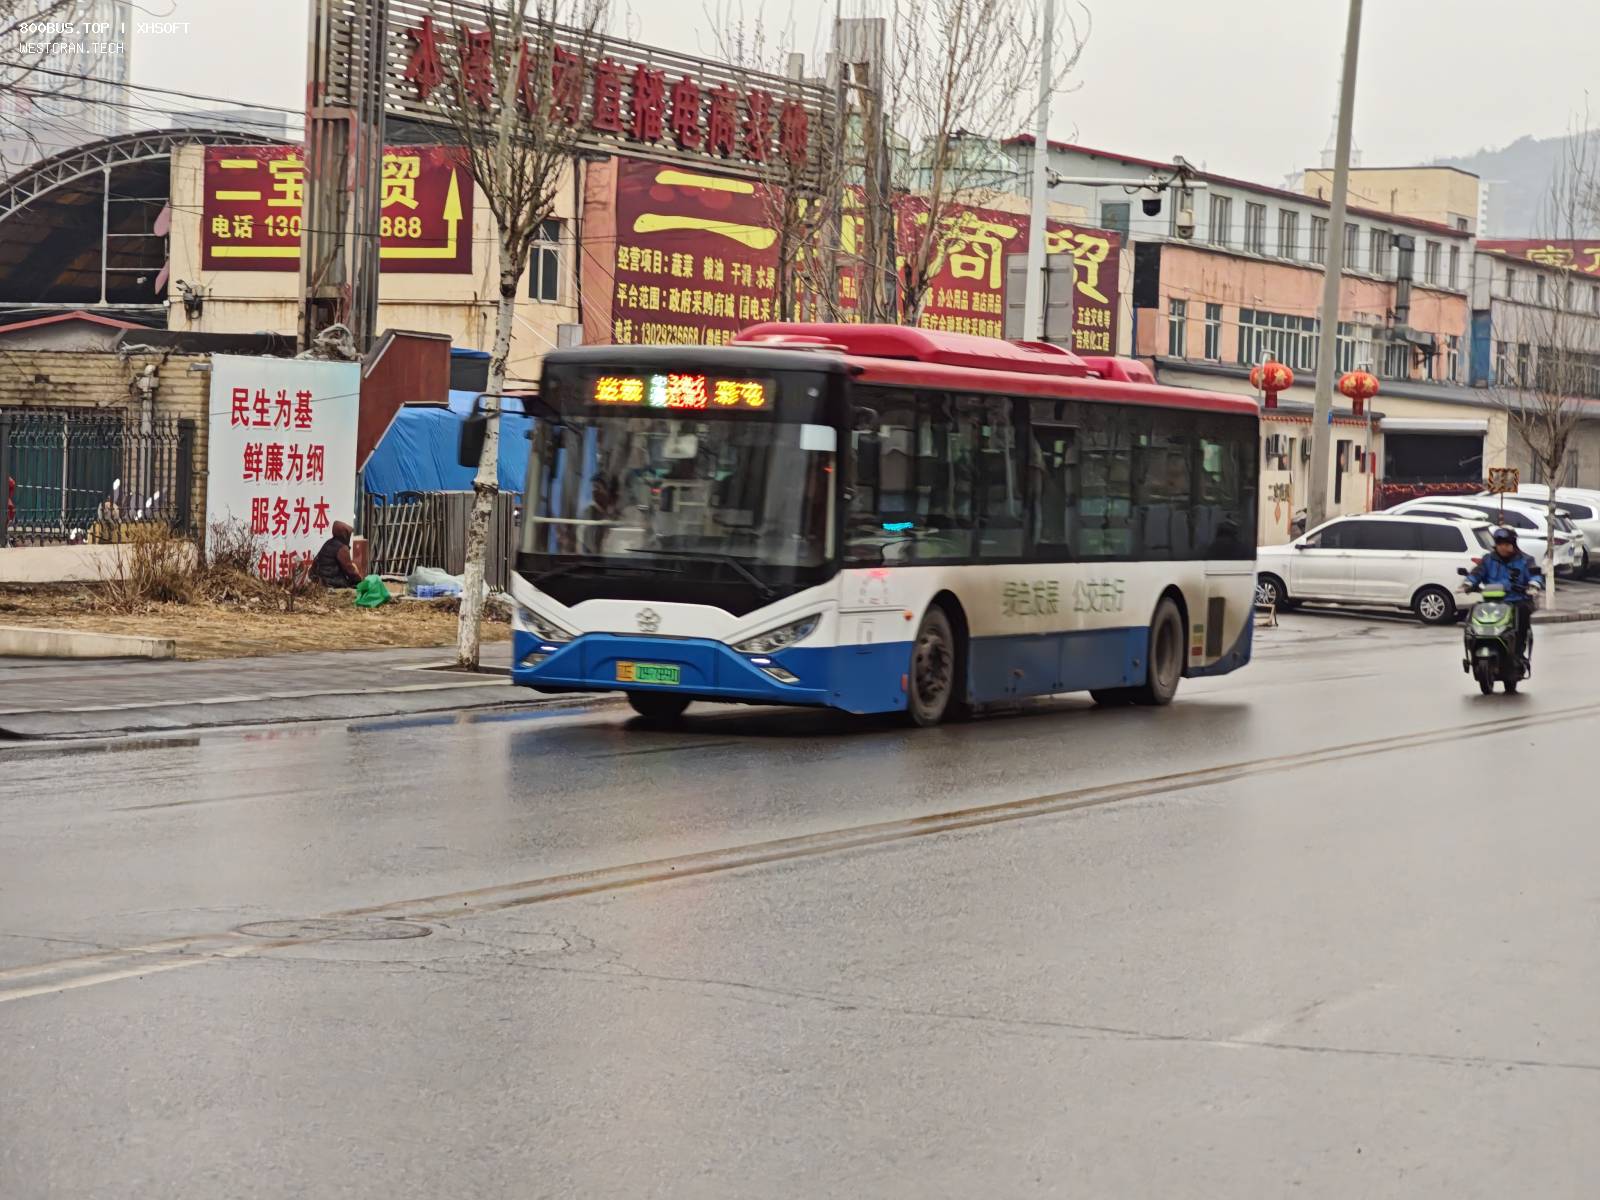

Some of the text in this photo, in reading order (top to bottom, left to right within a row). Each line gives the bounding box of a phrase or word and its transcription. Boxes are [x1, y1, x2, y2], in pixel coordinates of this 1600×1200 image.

[211, 214, 254, 239] 电话
[230, 387, 313, 429] 民生为基
[251, 495, 331, 536] 服务为本
